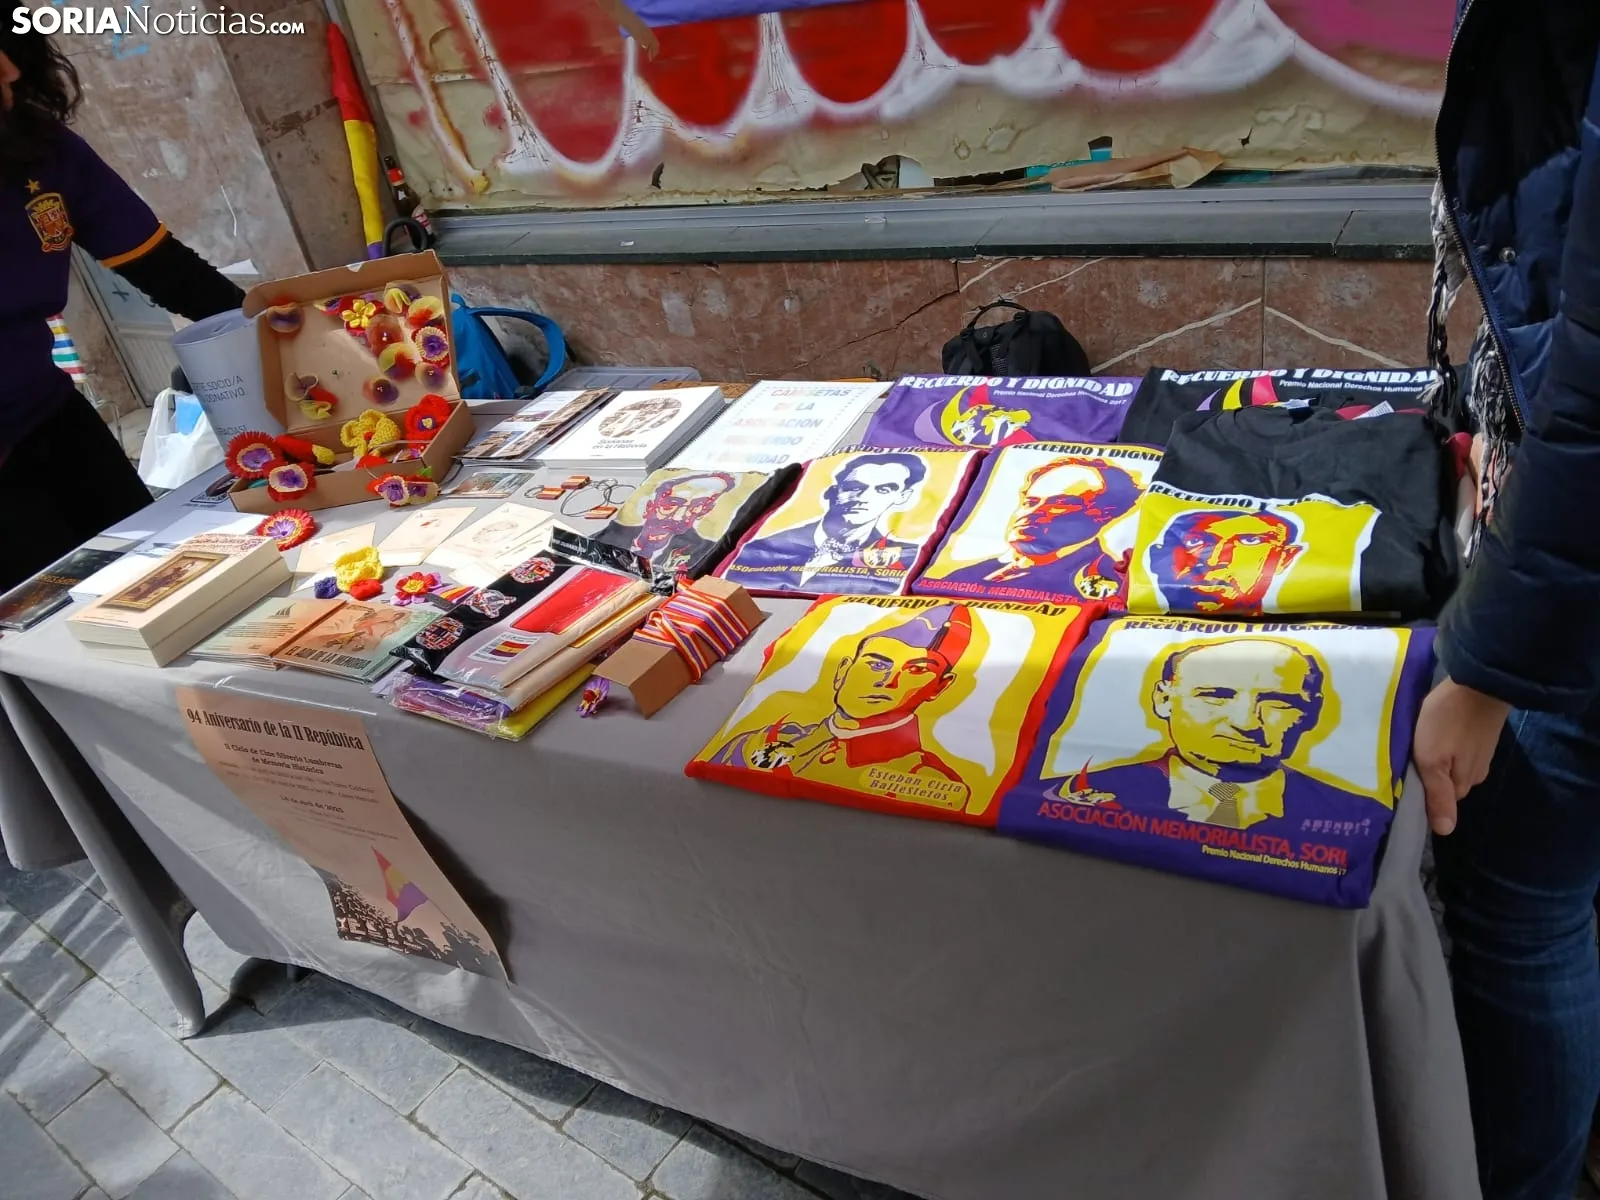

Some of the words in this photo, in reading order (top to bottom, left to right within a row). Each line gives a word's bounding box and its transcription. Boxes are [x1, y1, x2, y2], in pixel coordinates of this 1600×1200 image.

[1159, 368, 1288, 386] RECUERDO
[1293, 368, 1309, 379] Y
[898, 375, 1003, 390] RECUERDO
[1006, 377, 1022, 388] Y
[1021, 377, 1134, 397] DIGNIDAD
[1279, 380, 1306, 388] Premio
[1307, 380, 1343, 389] Nacional
[1344, 382, 1382, 392] Derechos
[795, 402, 816, 411] LA
[1012, 443, 1095, 456] RECUERDO
[1099, 446, 1108, 457] Y
[876, 567, 908, 577] SORIA
[964, 600, 1067, 617] DIGNIDAD
[1124, 620, 1238, 634] RECUERDO
[186, 707, 202, 725] 94
[202, 710, 262, 735] Aniversario
[263, 720, 278, 739] de
[280, 722, 292, 739] la
[293, 724, 304, 741] II
[304, 726, 365, 751] República
[868, 767, 922, 786] Esteban
[1037, 801, 1147, 833] ASOCIACIÓN
[1150, 817, 1296, 859] MEMORIALISTA,
[1202, 844, 1229, 858] Premio
[1229, 849, 1262, 863] Nacional
[1263, 854, 1300, 869] Derechos
[1300, 861, 1338, 875] Humanos
